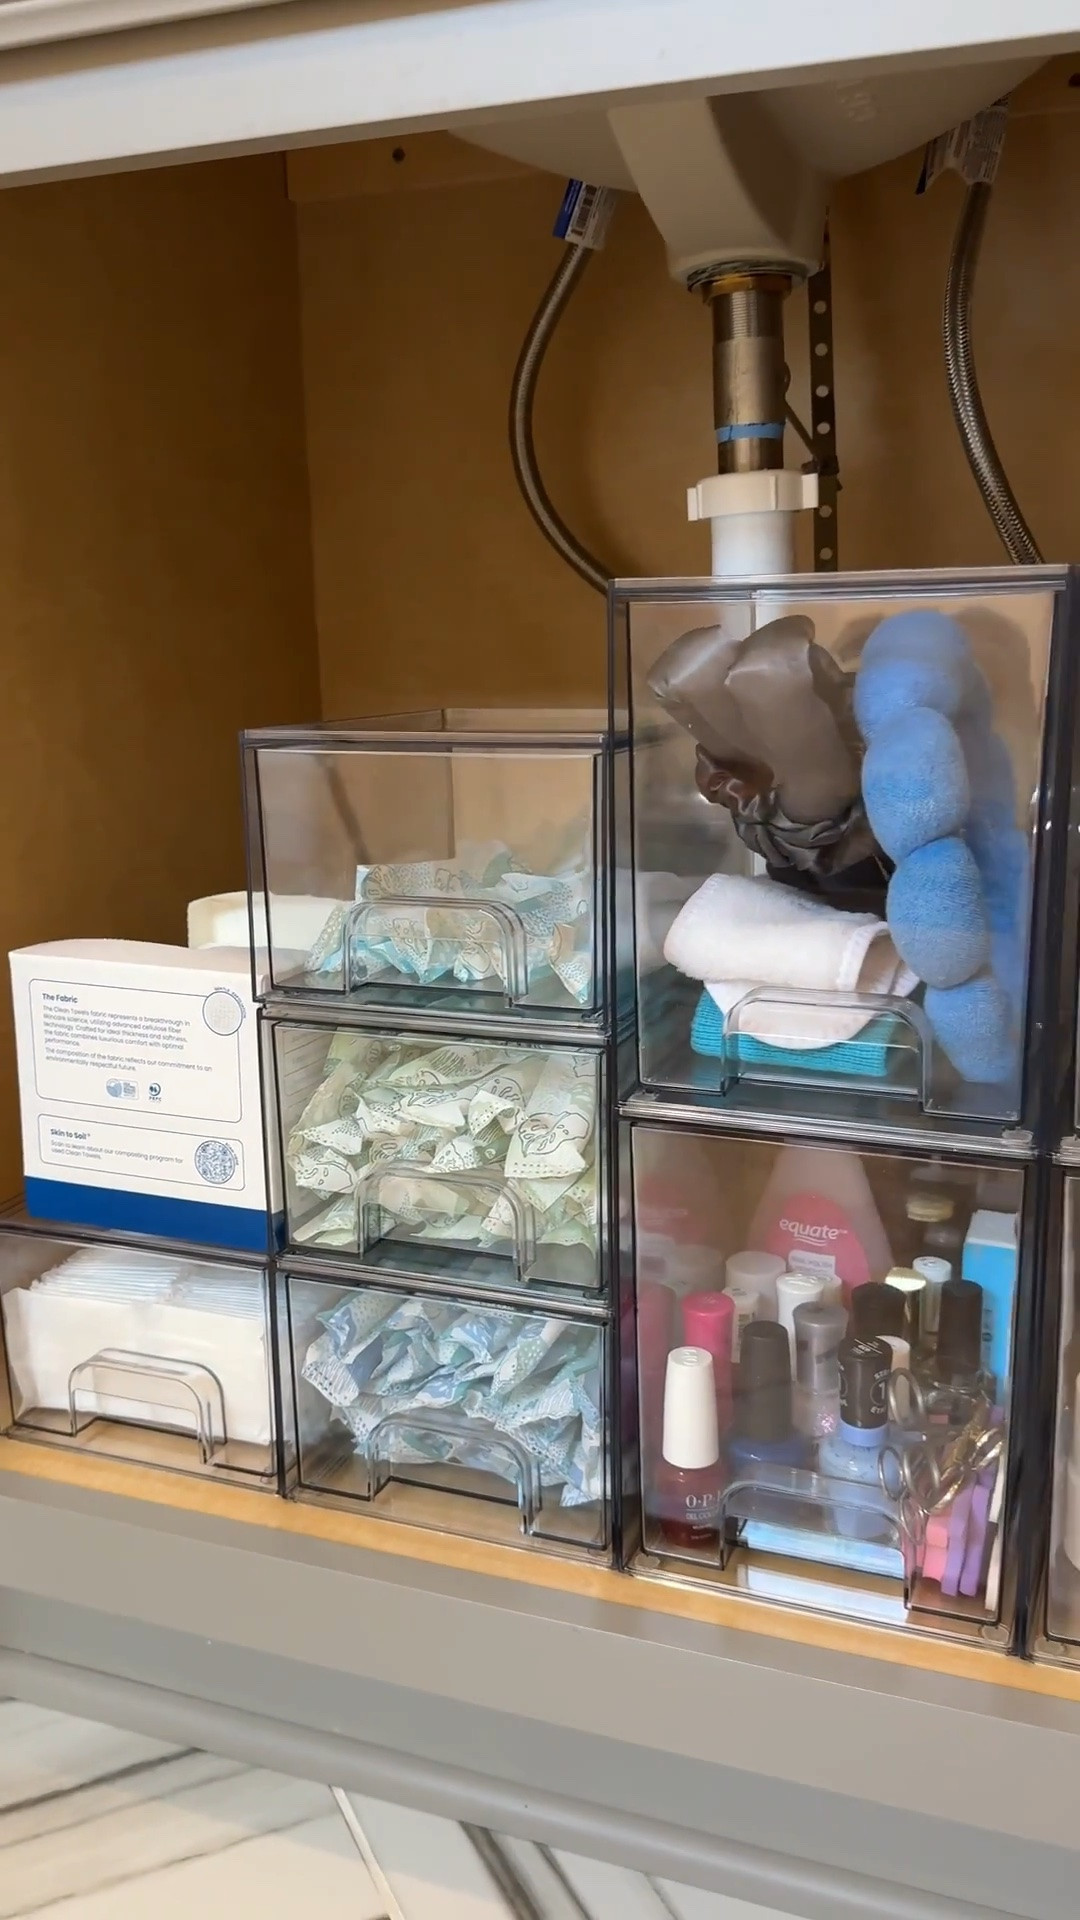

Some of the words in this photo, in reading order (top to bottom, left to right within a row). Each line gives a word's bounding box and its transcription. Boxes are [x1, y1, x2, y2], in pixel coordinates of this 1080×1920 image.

[42, 993, 55, 1002] The
[56, 994, 78, 1004] Fabric
[53, 1006, 70, 1014] Clean
[71, 1008, 90, 1016] Towels
[90, 1010, 107, 1018] fabric
[108, 1012, 137, 1022] represents
[144, 1016, 183, 1027] breakthrough
[75, 1025, 97, 1033] Crafted
[122, 1030, 148, 1038] thickness
[112, 1021, 142, 1029] advanced
[142, 1024, 167, 1032] cellulose
[70, 1033, 98, 1041] combines
[125, 1038, 148, 1046] comfort
[162, 1042, 184, 1051] optimal
[46, 1056, 88, 1067] environmentally
[89, 1061, 117, 1070] respectful
[56, 1049, 90, 1059] composition
[125, 1056, 146, 1064] reflects
[157, 1060, 196, 1069] commitment
[50, 1129, 65, 1137] Skin
[65, 1130, 73, 1138] to
[86, 1145, 103, 1153] about
[114, 1149, 148, 1160] composting
[149, 1153, 174, 1164] program
[779, 1218, 839, 1240] equate
[878, 1381, 886, 1400] 1
